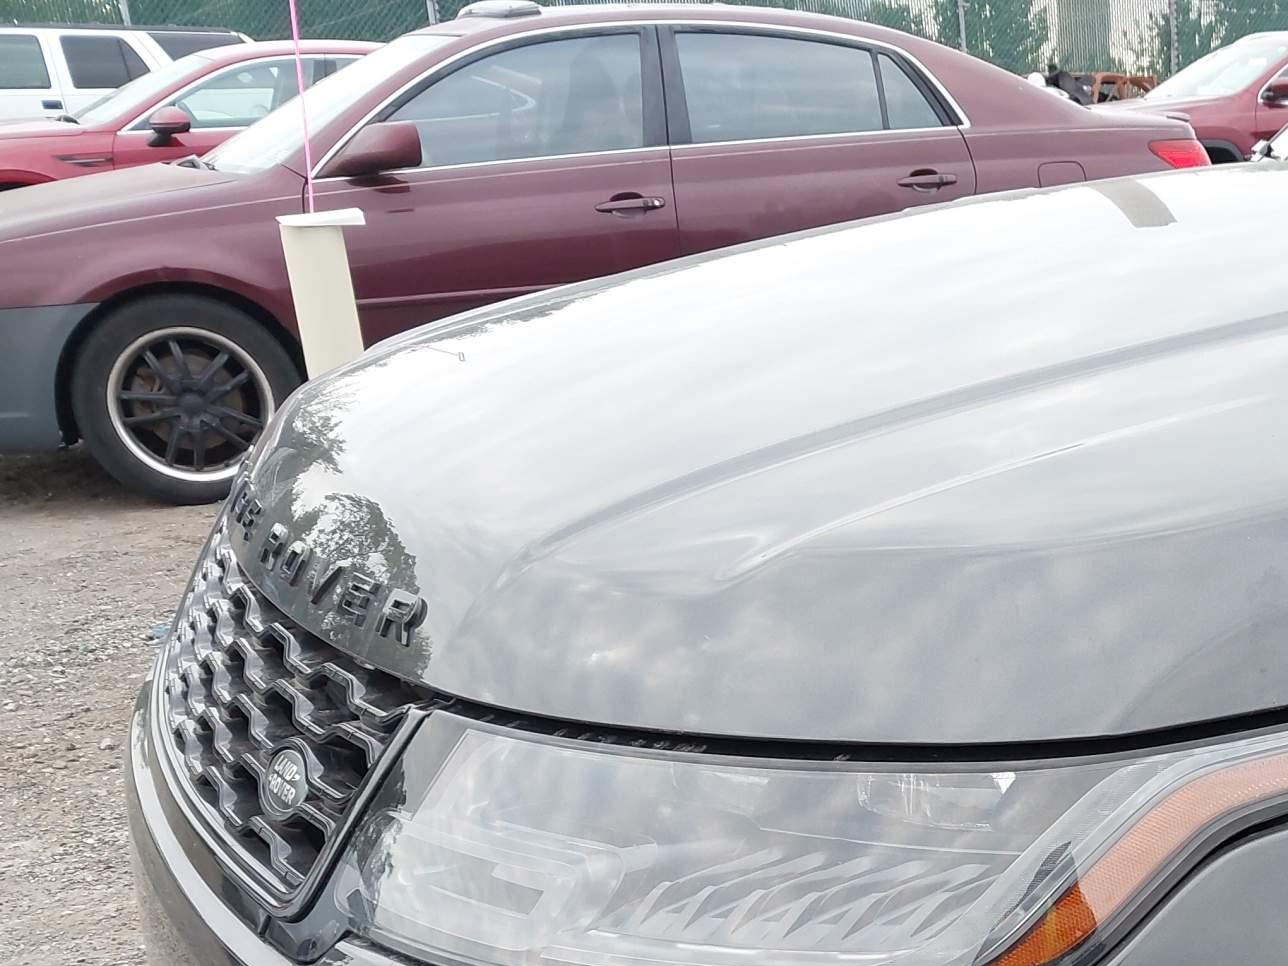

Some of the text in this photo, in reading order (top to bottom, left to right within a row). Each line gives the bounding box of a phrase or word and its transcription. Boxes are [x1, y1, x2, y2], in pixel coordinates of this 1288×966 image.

[257, 521, 428, 648] ROVER
[273, 754, 298, 781] LAND
[268, 773, 297, 806] ROVER
